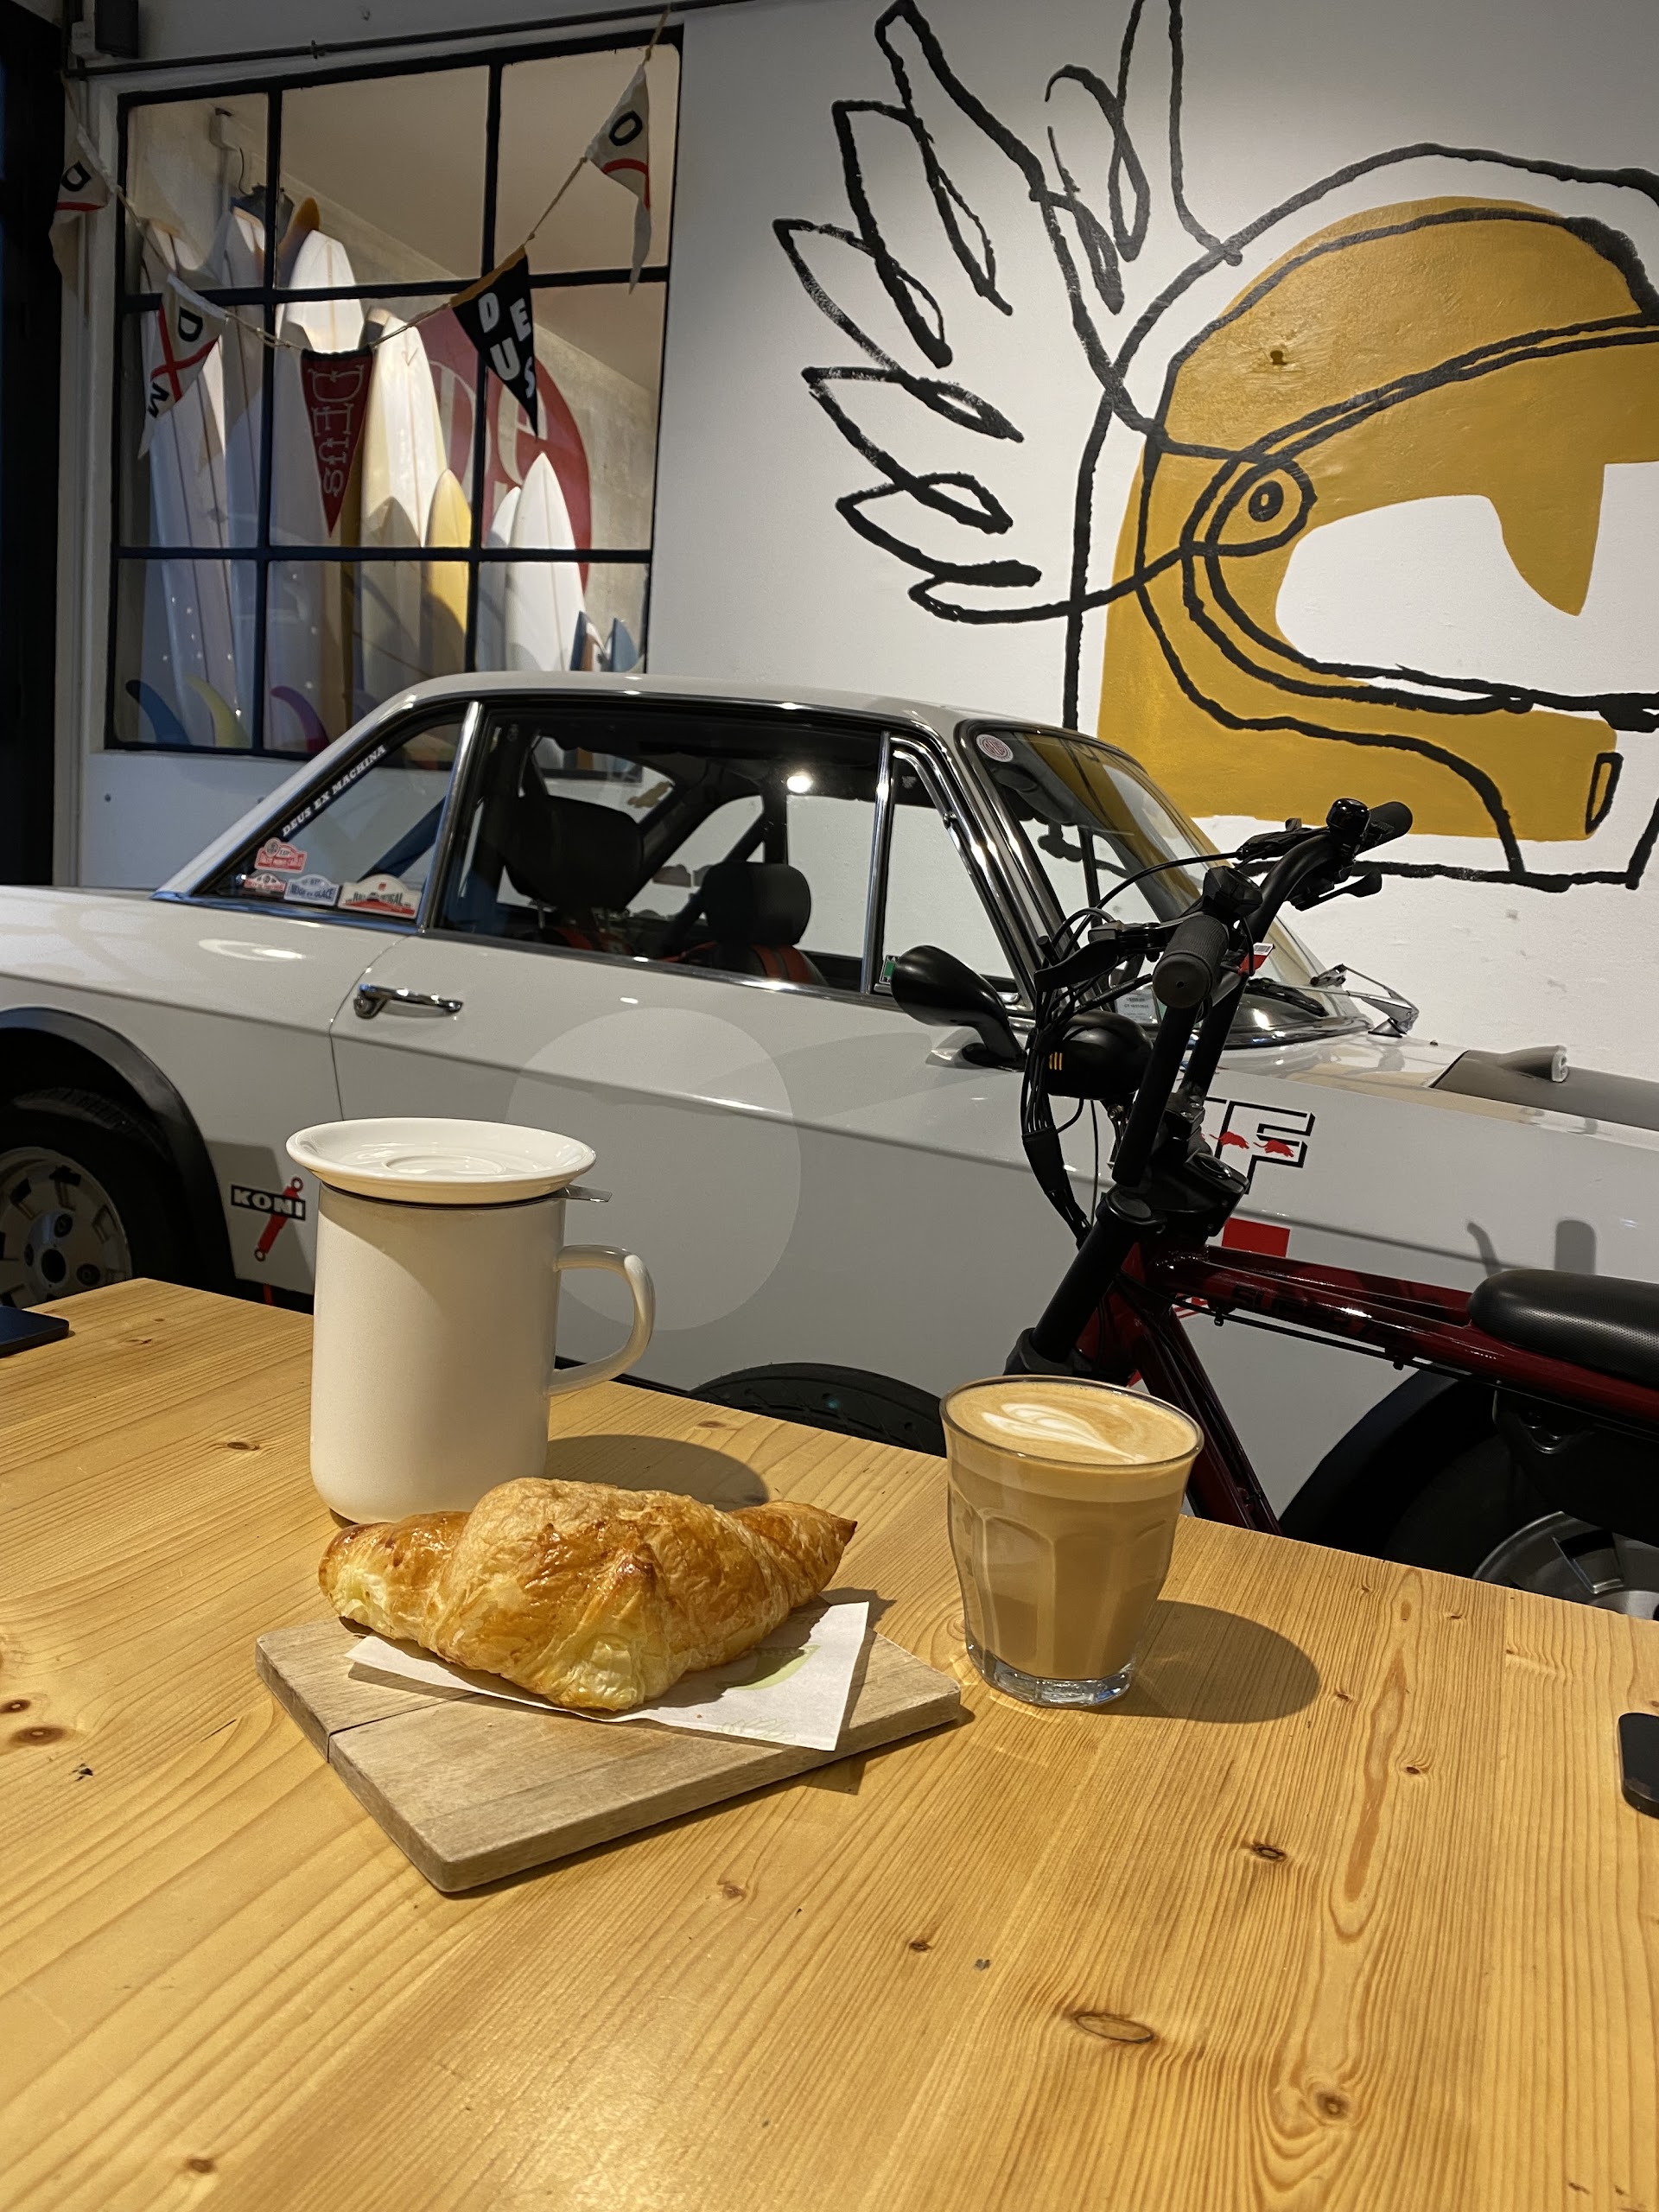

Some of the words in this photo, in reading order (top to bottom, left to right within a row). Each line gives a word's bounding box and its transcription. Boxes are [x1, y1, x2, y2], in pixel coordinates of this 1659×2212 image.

[308, 364, 365, 498] DEUS
[283, 806, 311, 836] DEUS
[313, 790, 331, 810] EX
[332, 744, 386, 795] MACHINA
[232, 1186, 303, 1218] KONI
